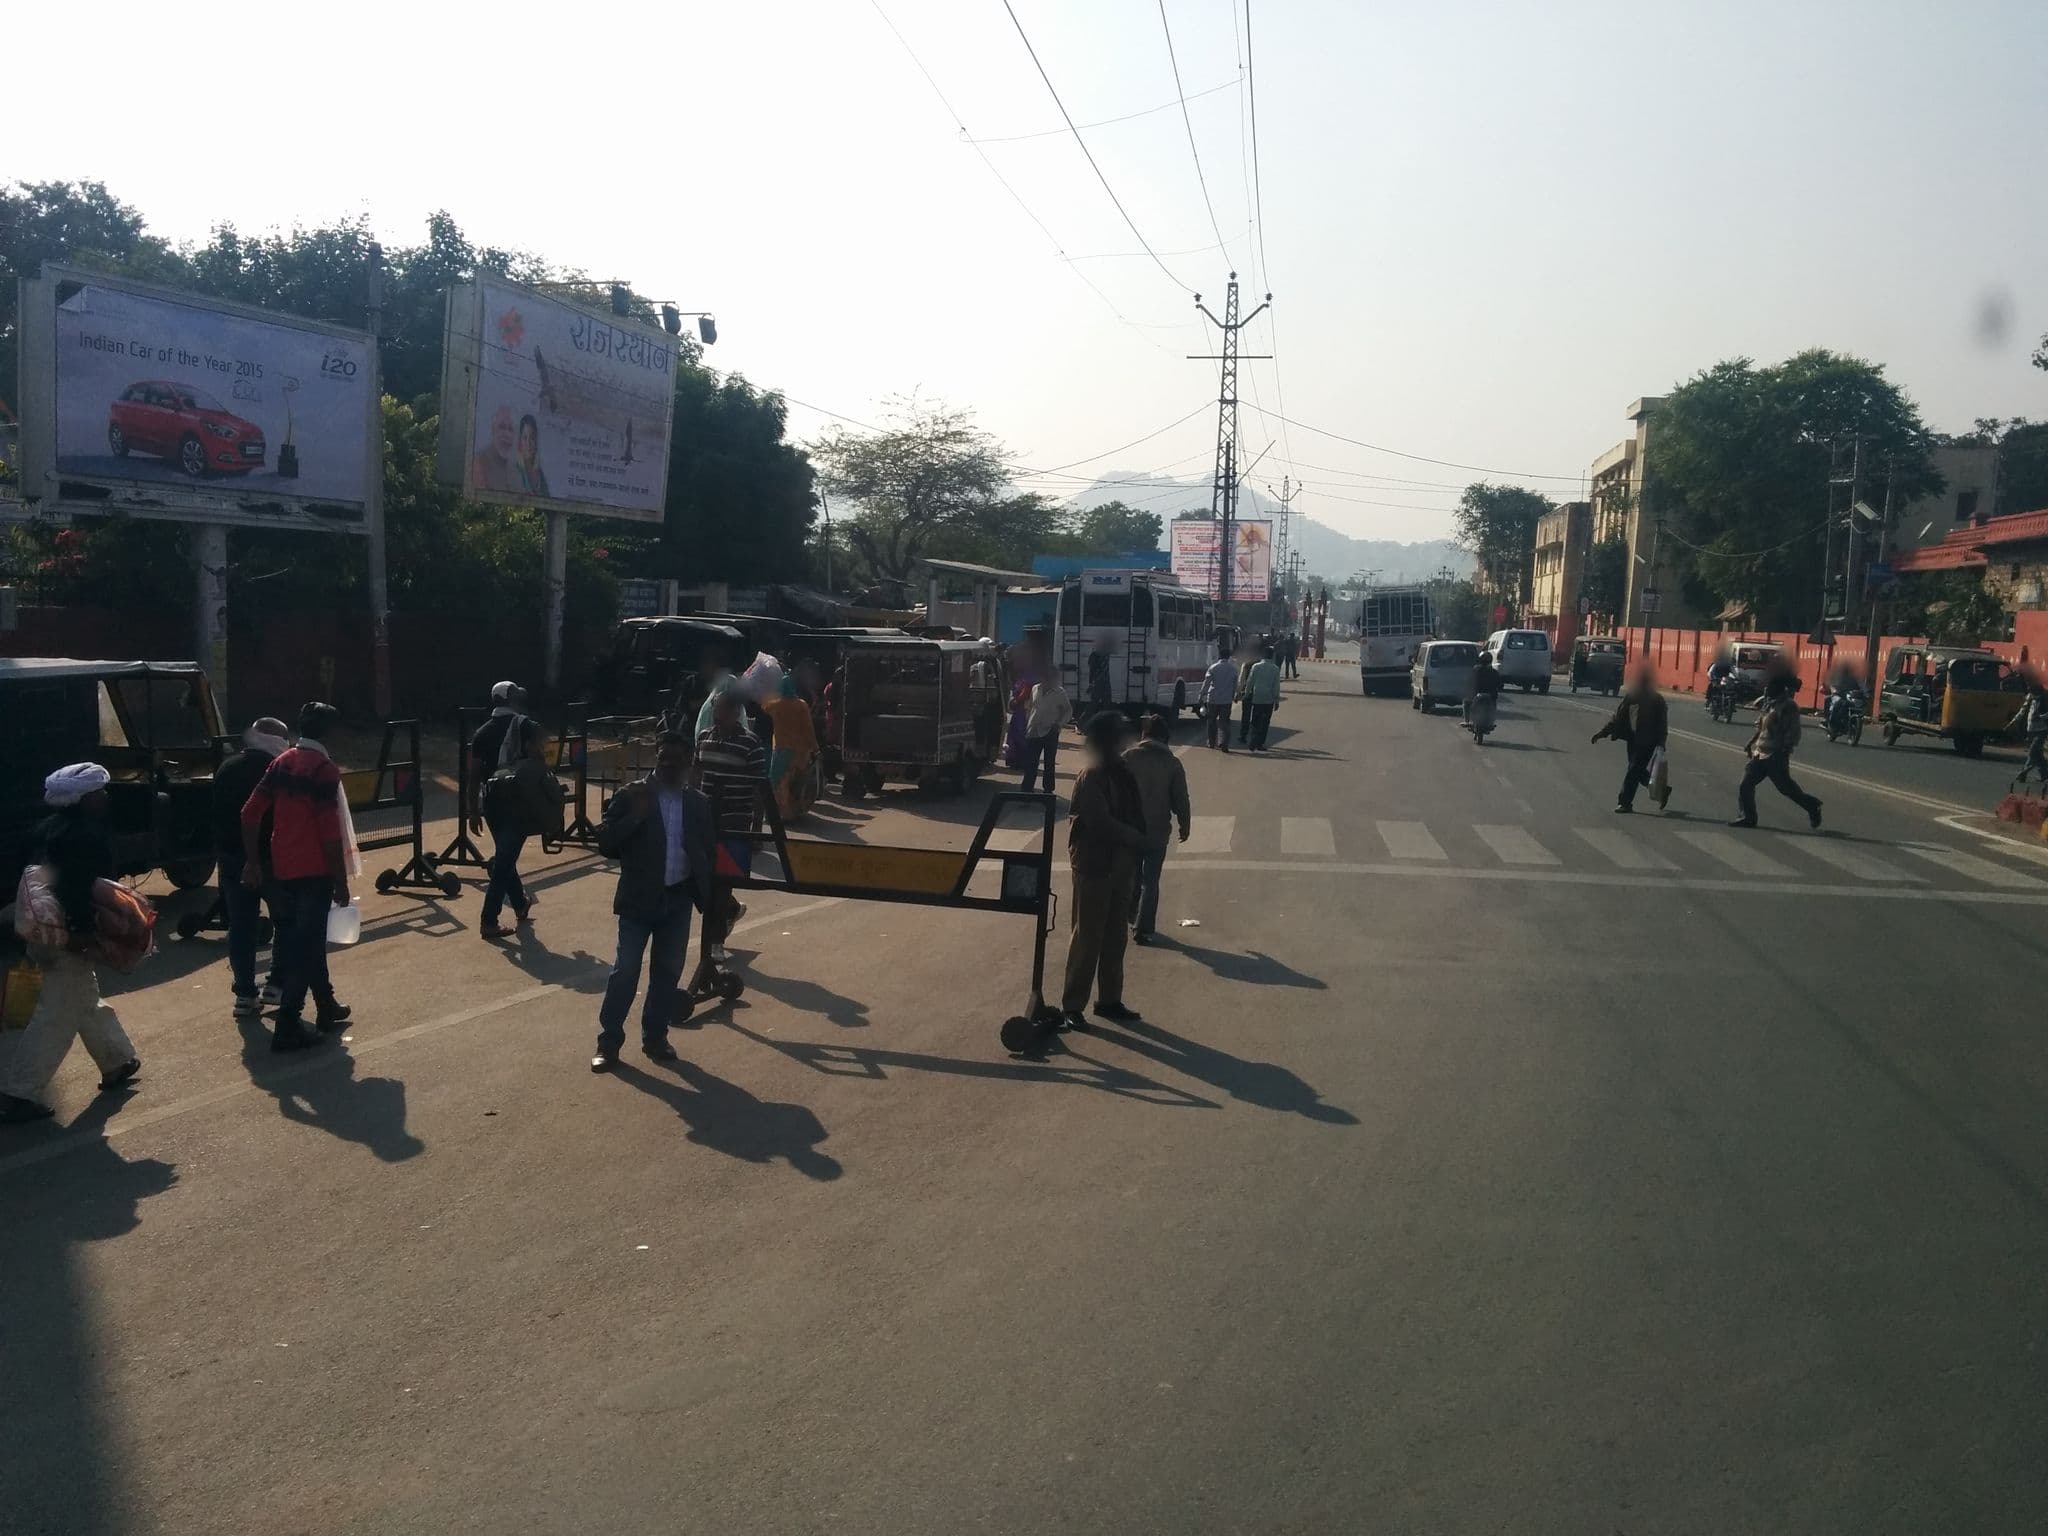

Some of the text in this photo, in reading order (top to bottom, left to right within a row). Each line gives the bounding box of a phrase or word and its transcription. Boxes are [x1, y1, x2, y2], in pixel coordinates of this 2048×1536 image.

[79, 331, 263, 378] Indian Car of the Year 2015
[321, 354, 357, 376] i20
[569, 315, 669, 374] राजस्थान
